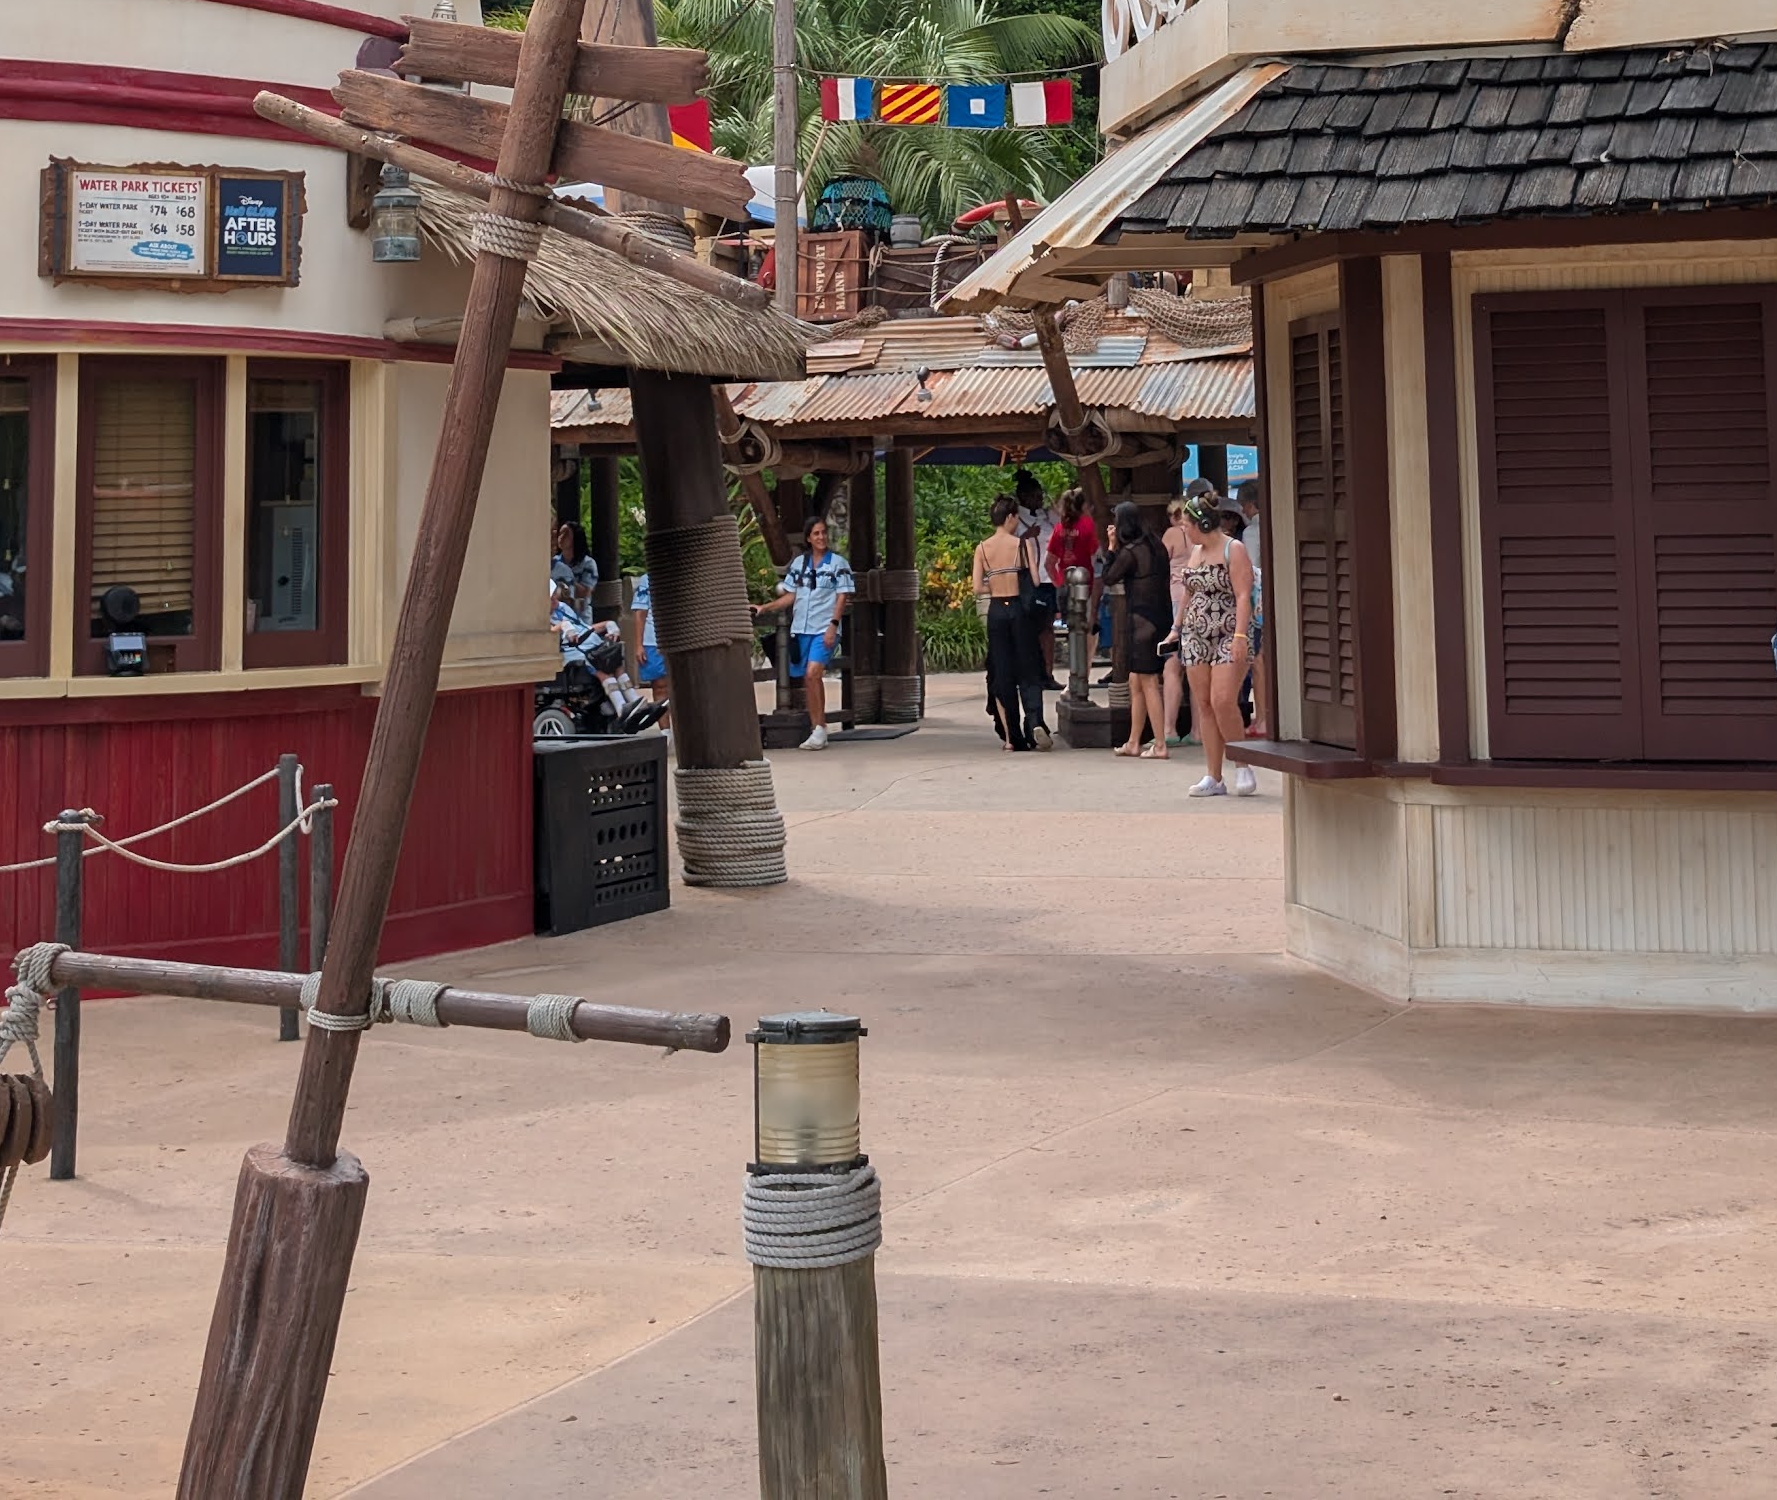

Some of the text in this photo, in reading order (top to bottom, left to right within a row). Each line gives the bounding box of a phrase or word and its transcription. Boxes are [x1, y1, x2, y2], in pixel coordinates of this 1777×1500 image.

[79, 179, 198, 194] WATER PARK TICKETS
[150, 205, 168, 217] $74
[176, 206, 196, 218] $68
[99, 221, 120, 229] WATER
[150, 223, 168, 235] $64
[176, 224, 196, 236] $58
[225, 217, 276, 232] AFTER
[224, 231, 277, 246] HOURS
[815, 245, 825, 309] EASTPORT
[835, 271, 845, 310] MAINE
